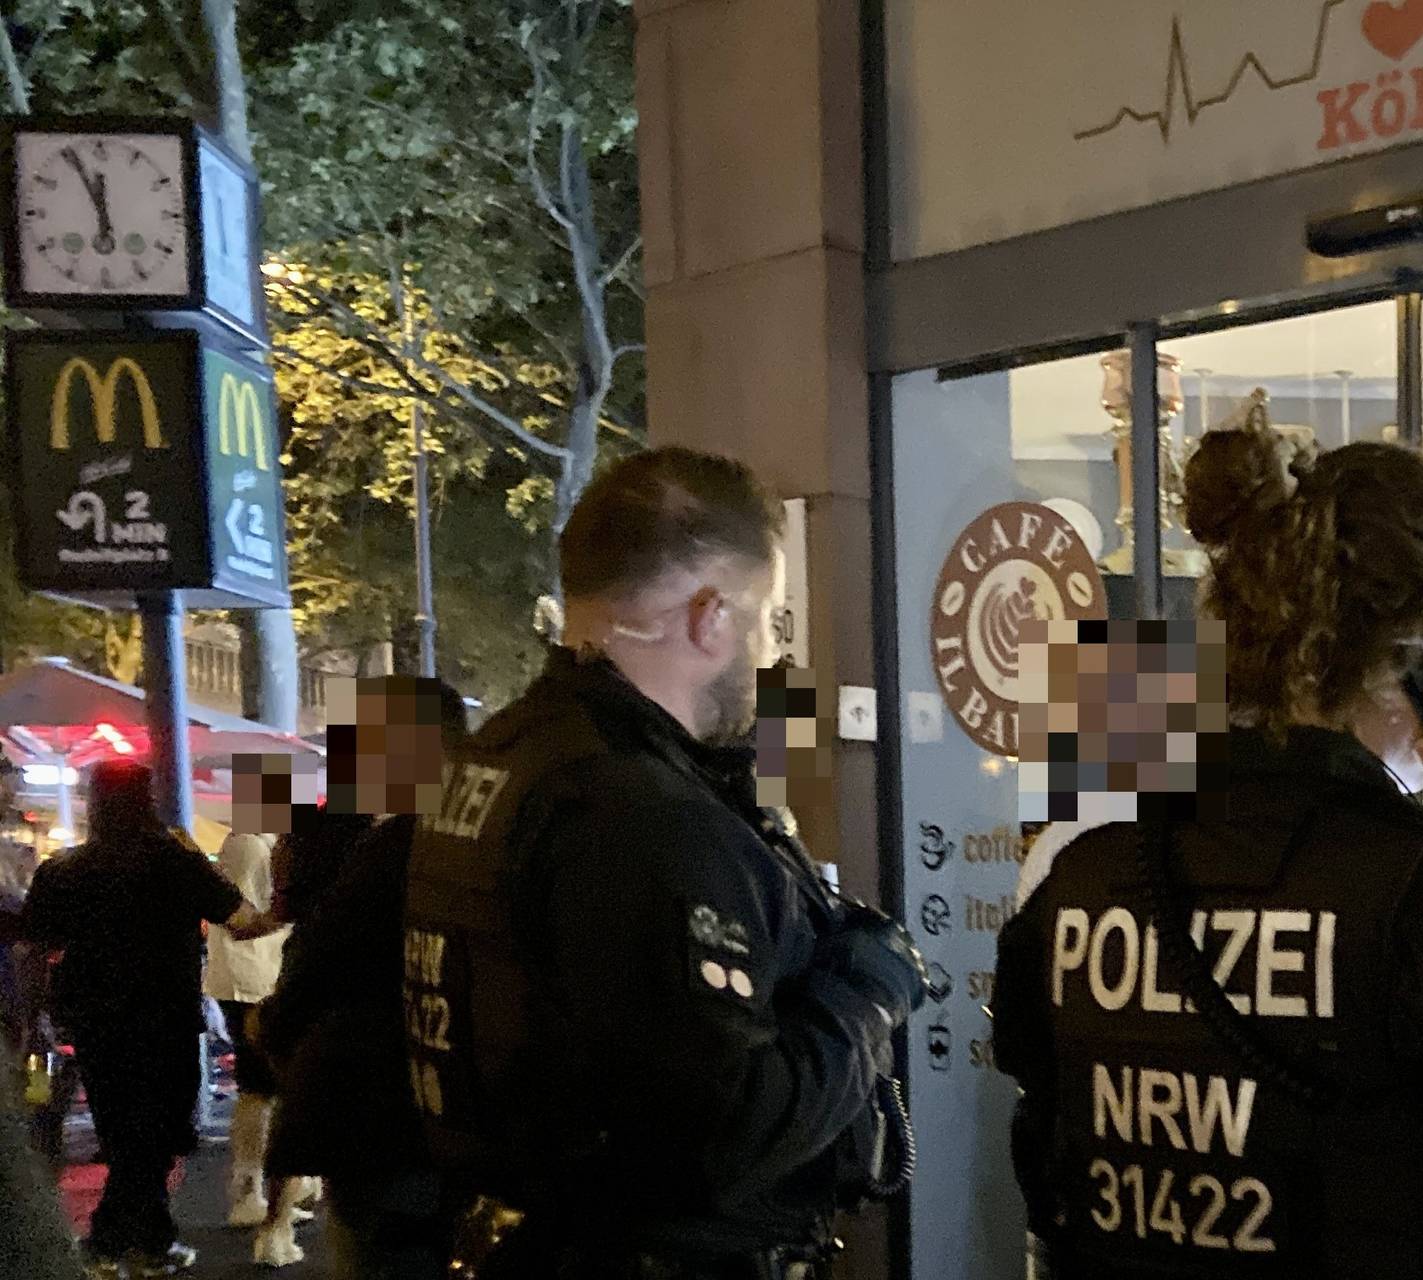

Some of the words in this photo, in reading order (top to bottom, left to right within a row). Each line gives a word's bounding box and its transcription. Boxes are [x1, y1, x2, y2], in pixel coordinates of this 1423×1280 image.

[125, 490, 150, 519] 2
[248, 504, 264, 536] 2
[960, 512, 1073, 573] CAFÉ
[935, 633, 966, 692] IL
[1092, 1062, 1258, 1158] NRW
[1088, 1158, 1277, 1252] 31422
